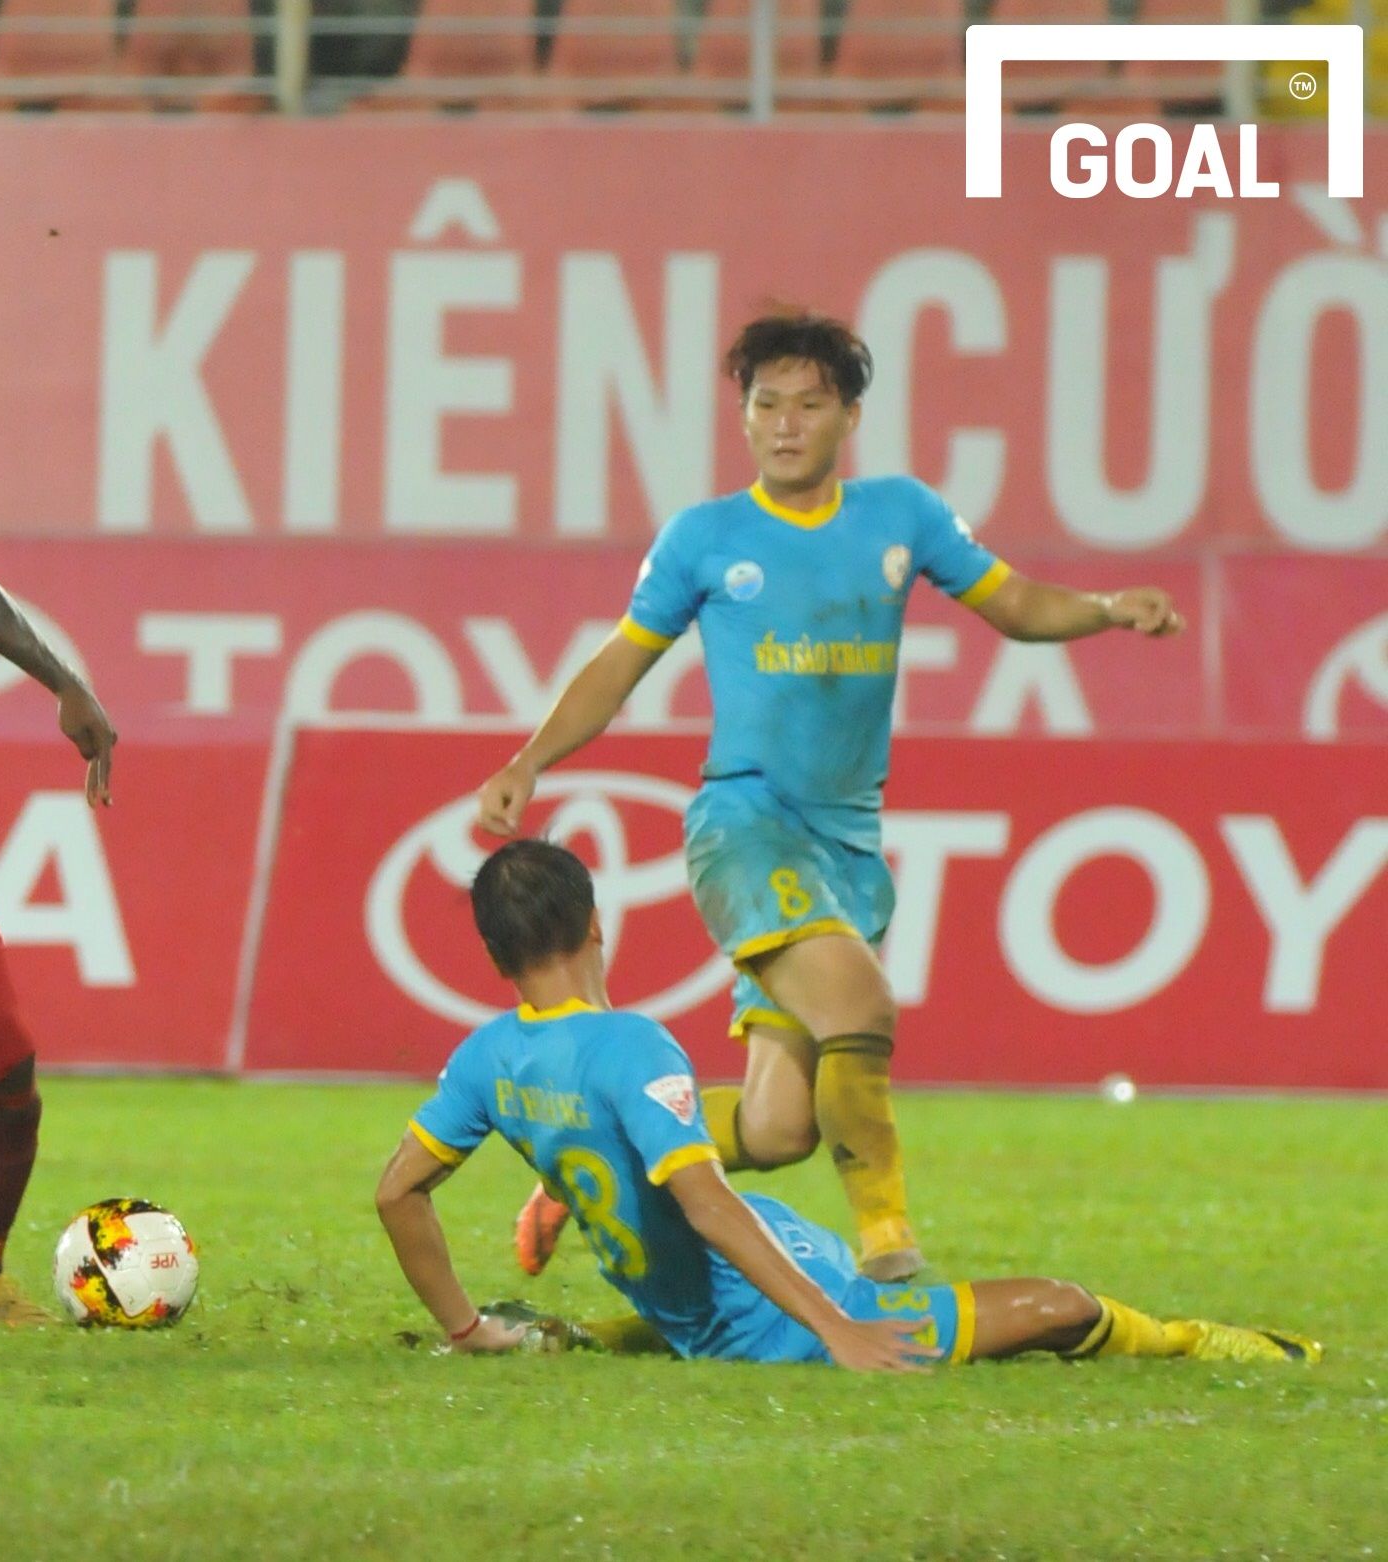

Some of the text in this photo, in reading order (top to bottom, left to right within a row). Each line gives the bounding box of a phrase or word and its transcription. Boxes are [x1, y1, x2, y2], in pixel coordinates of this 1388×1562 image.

[96, 177, 720, 537] KIÊN
[768, 866, 815, 920] 8
[150, 1253, 180, 1269] VPF
